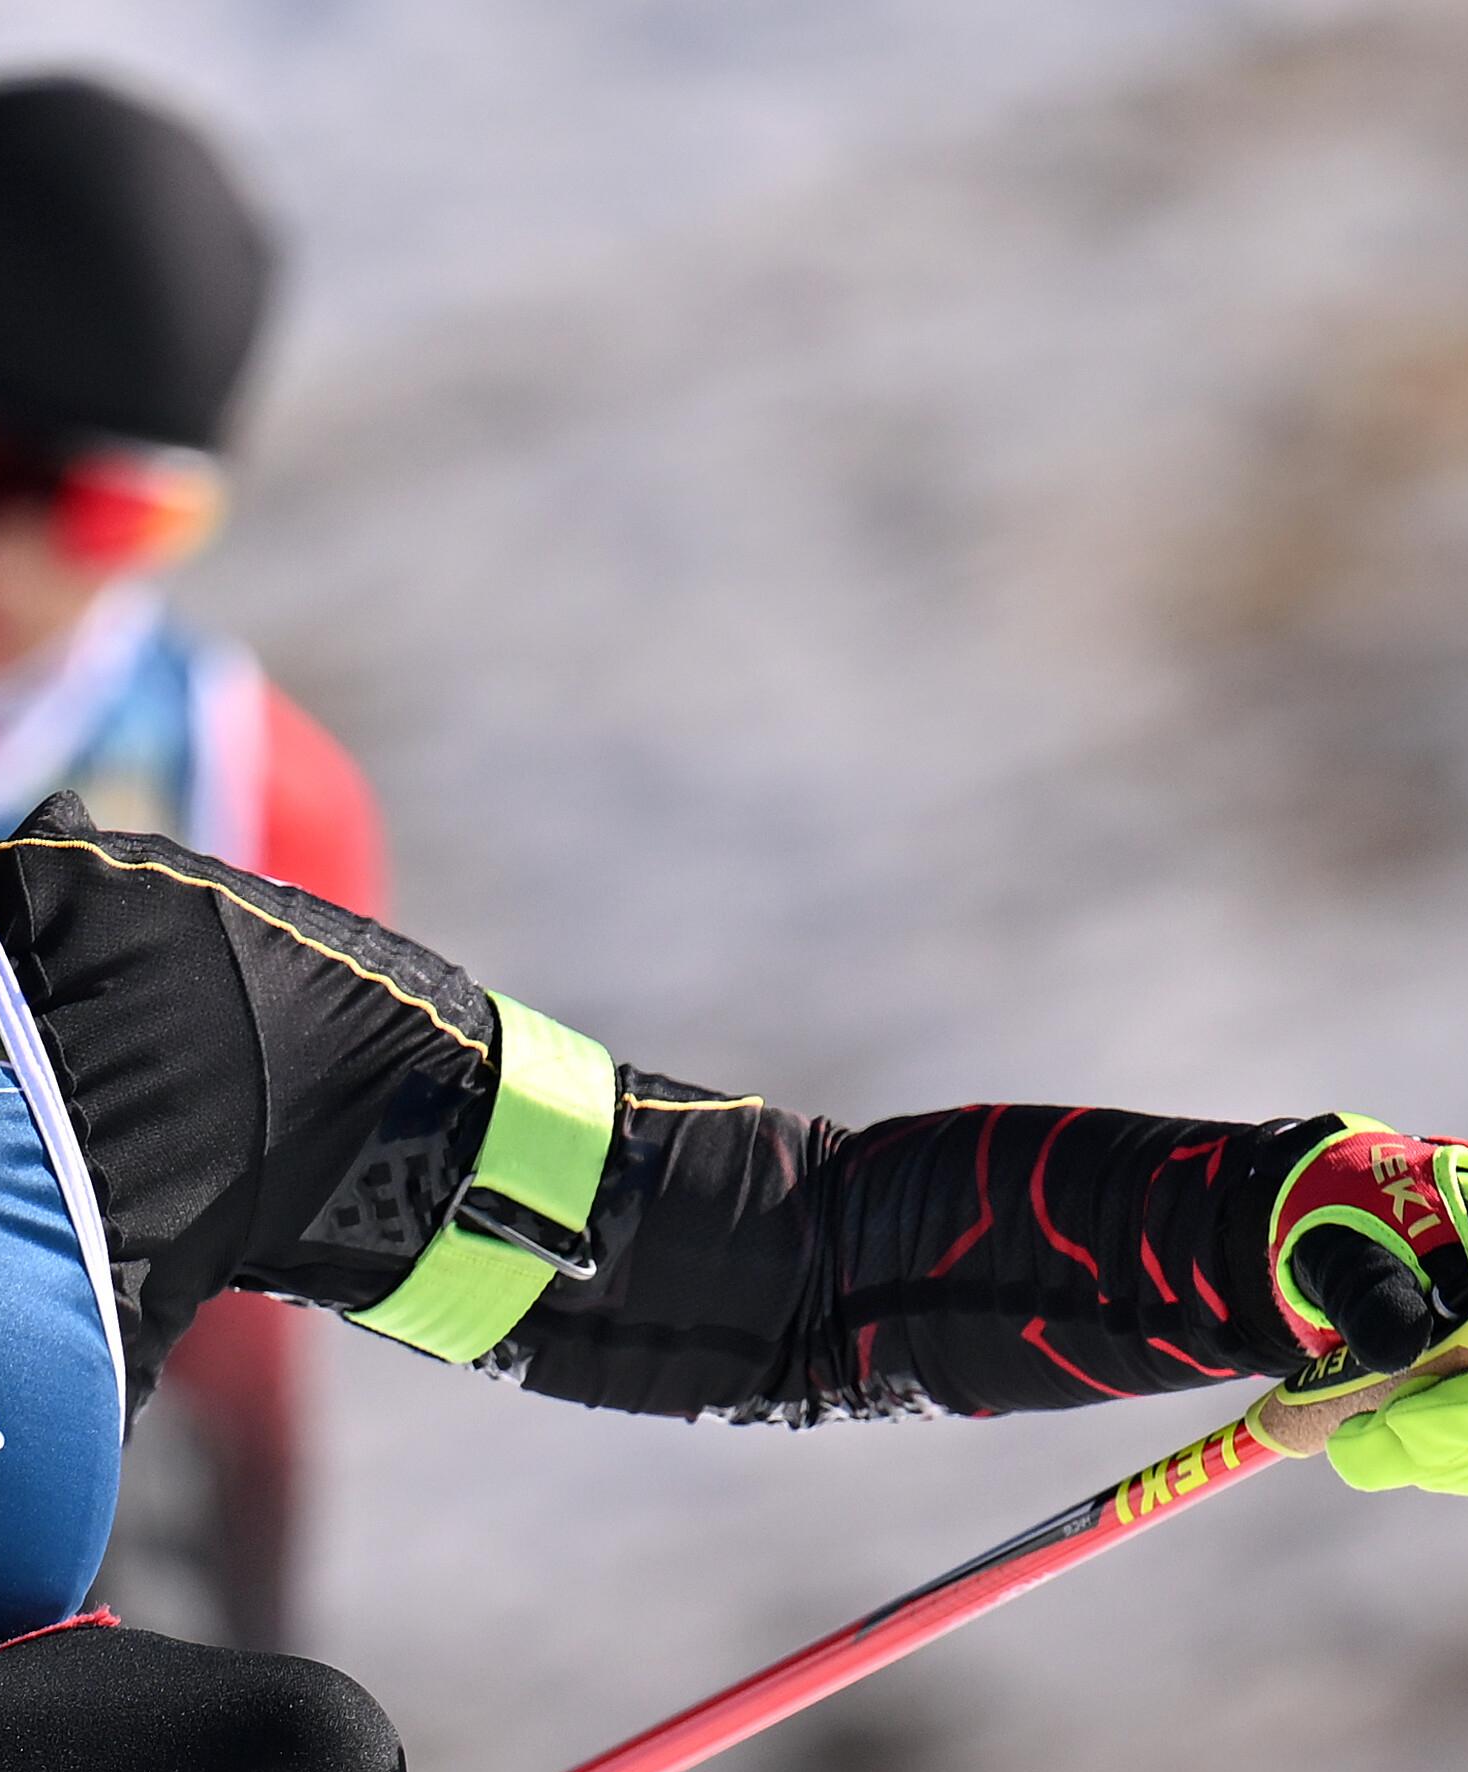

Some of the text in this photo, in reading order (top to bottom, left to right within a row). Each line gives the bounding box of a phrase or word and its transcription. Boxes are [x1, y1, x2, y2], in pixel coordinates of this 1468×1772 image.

[1370, 1142, 1442, 1239] LEKI
[1296, 1345, 1350, 1388] EKI
[1114, 1421, 1242, 1525] LEKI
